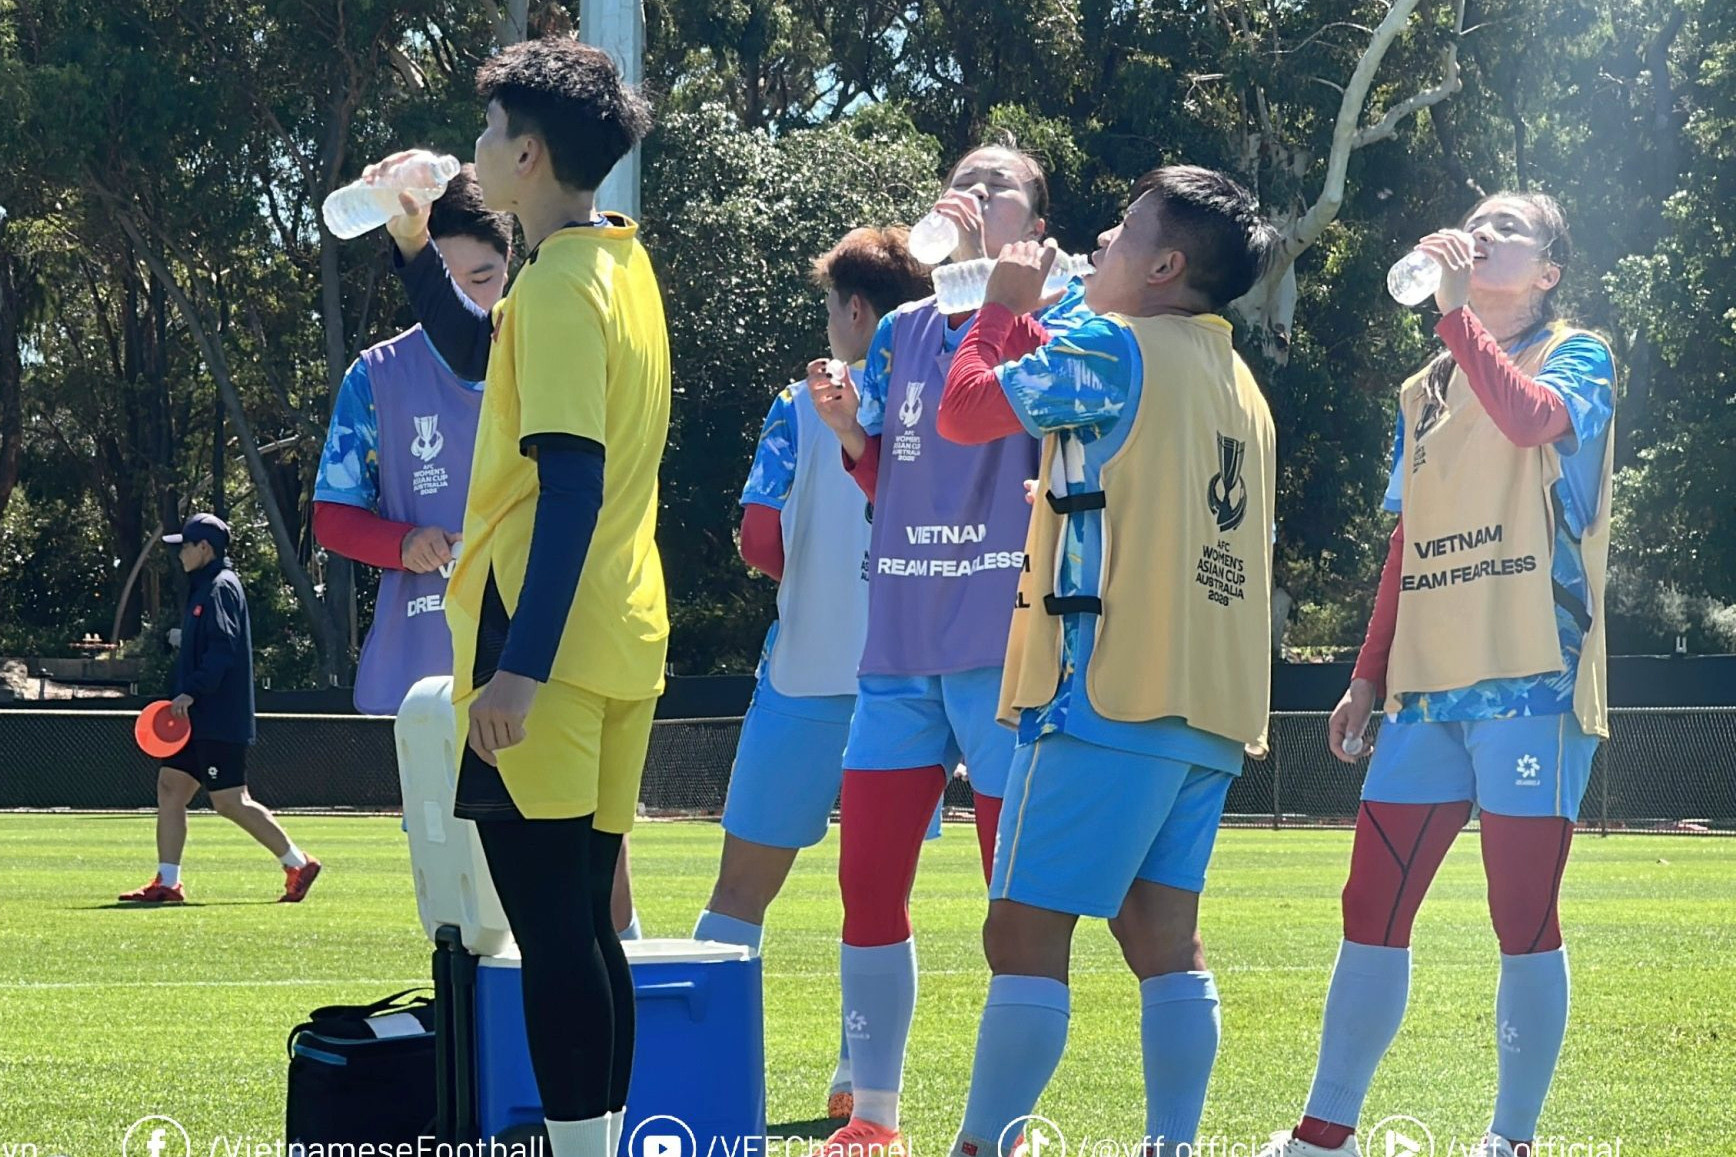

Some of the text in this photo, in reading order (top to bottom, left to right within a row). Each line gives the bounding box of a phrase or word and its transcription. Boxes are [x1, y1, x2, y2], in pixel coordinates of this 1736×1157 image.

[1217, 539, 1230, 552] AFC
[1414, 524, 1503, 559] VIETNAM
[1197, 558, 1246, 586] ASIAN CUP
[1202, 545, 1244, 572] WOMEN'S
[1195, 572, 1245, 600] AUSTRALIA
[1400, 555, 1537, 592] EAM FEARLESS
[407, 594, 446, 617] DRE
